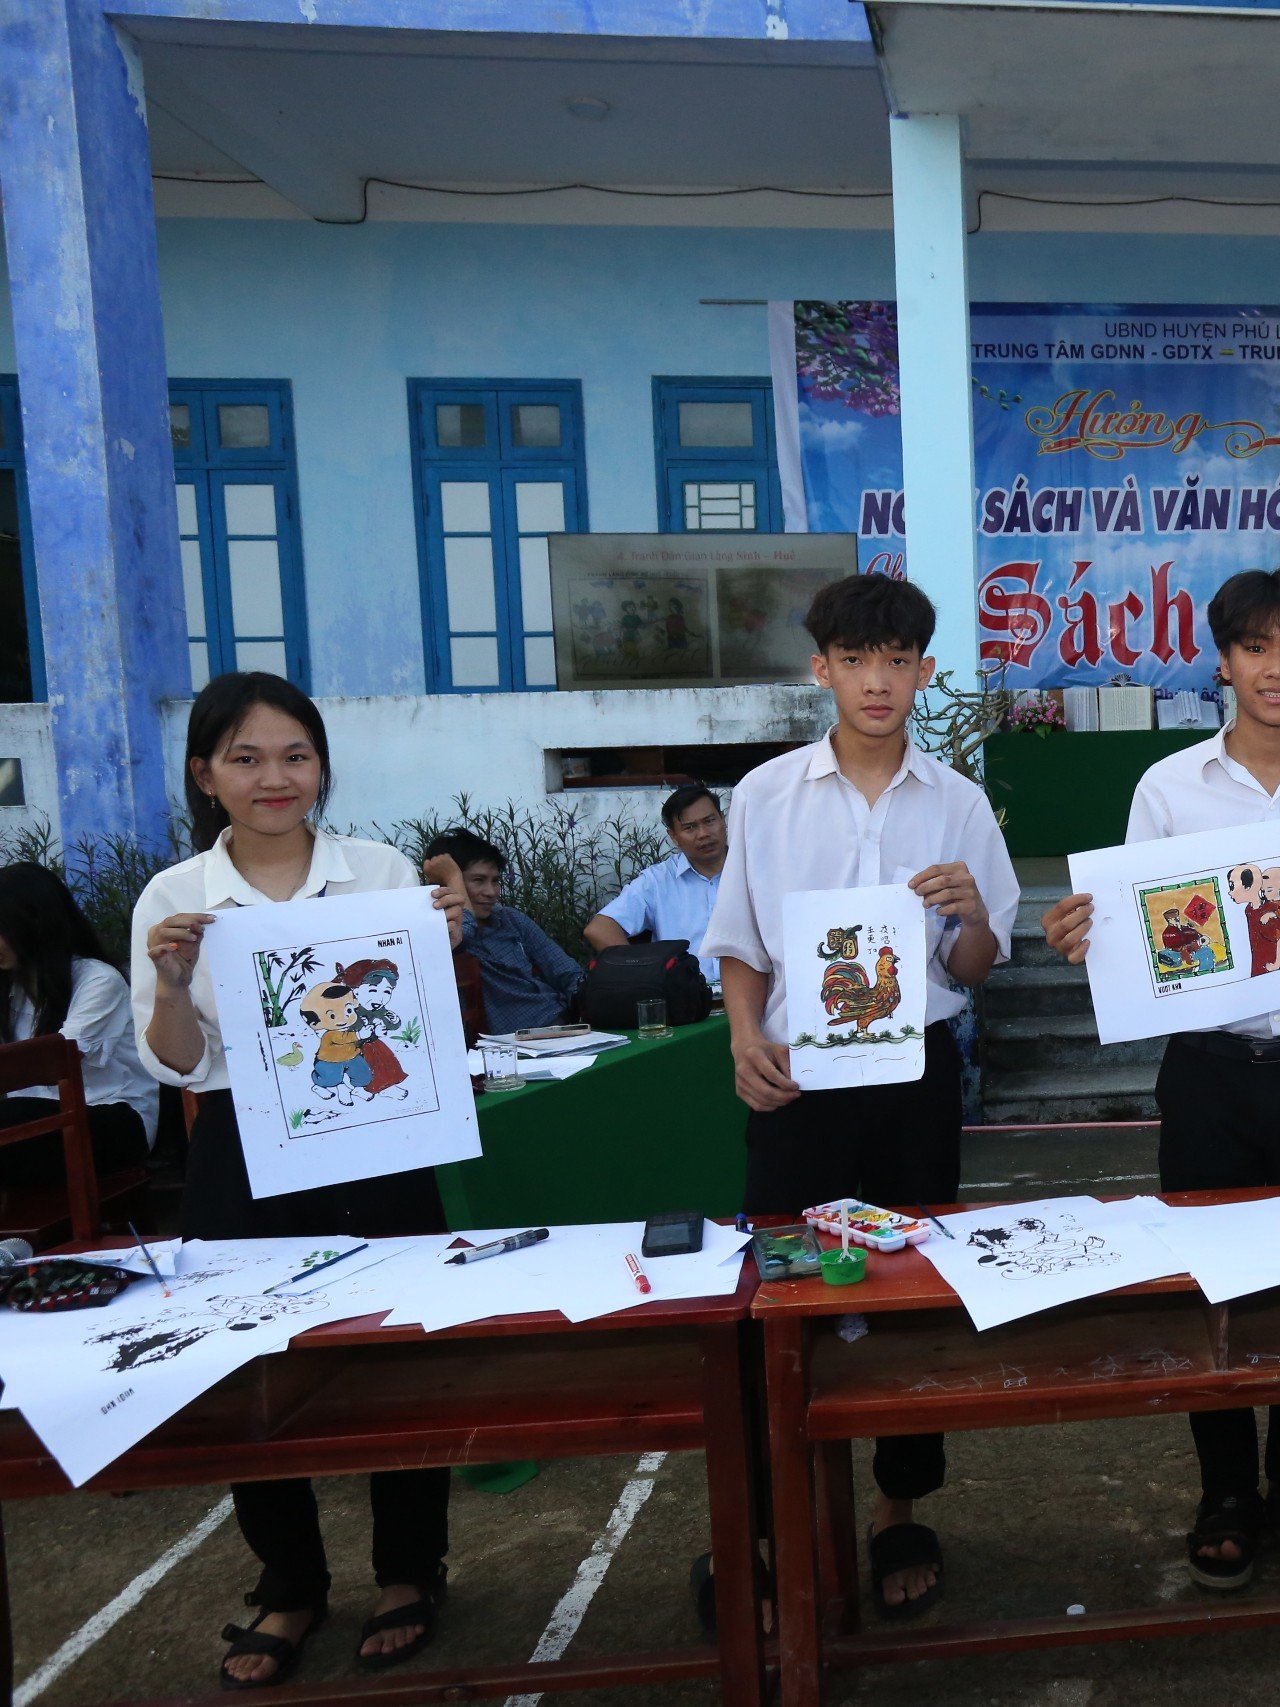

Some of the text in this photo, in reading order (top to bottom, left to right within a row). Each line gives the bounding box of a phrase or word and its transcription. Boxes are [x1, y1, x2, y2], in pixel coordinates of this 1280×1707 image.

[971, 343, 1039, 359] TRUNG
[1044, 340, 1084, 359] TÂM
[1091, 344, 1145, 360] GDNN
[1162, 344, 1213, 360] GDTX
[1104, 322, 1157, 338] UBND
[1163, 321, 1226, 342] HUYỆN
[1232, 320, 1270, 340] PHÚ
[1024, 389, 1205, 459] Hưởng
[980, 475, 1084, 534] SÁCH
[1092, 476, 1143, 533] VÀ
[1152, 474, 1232, 532] VĂN
[979, 560, 1202, 668] Sách
